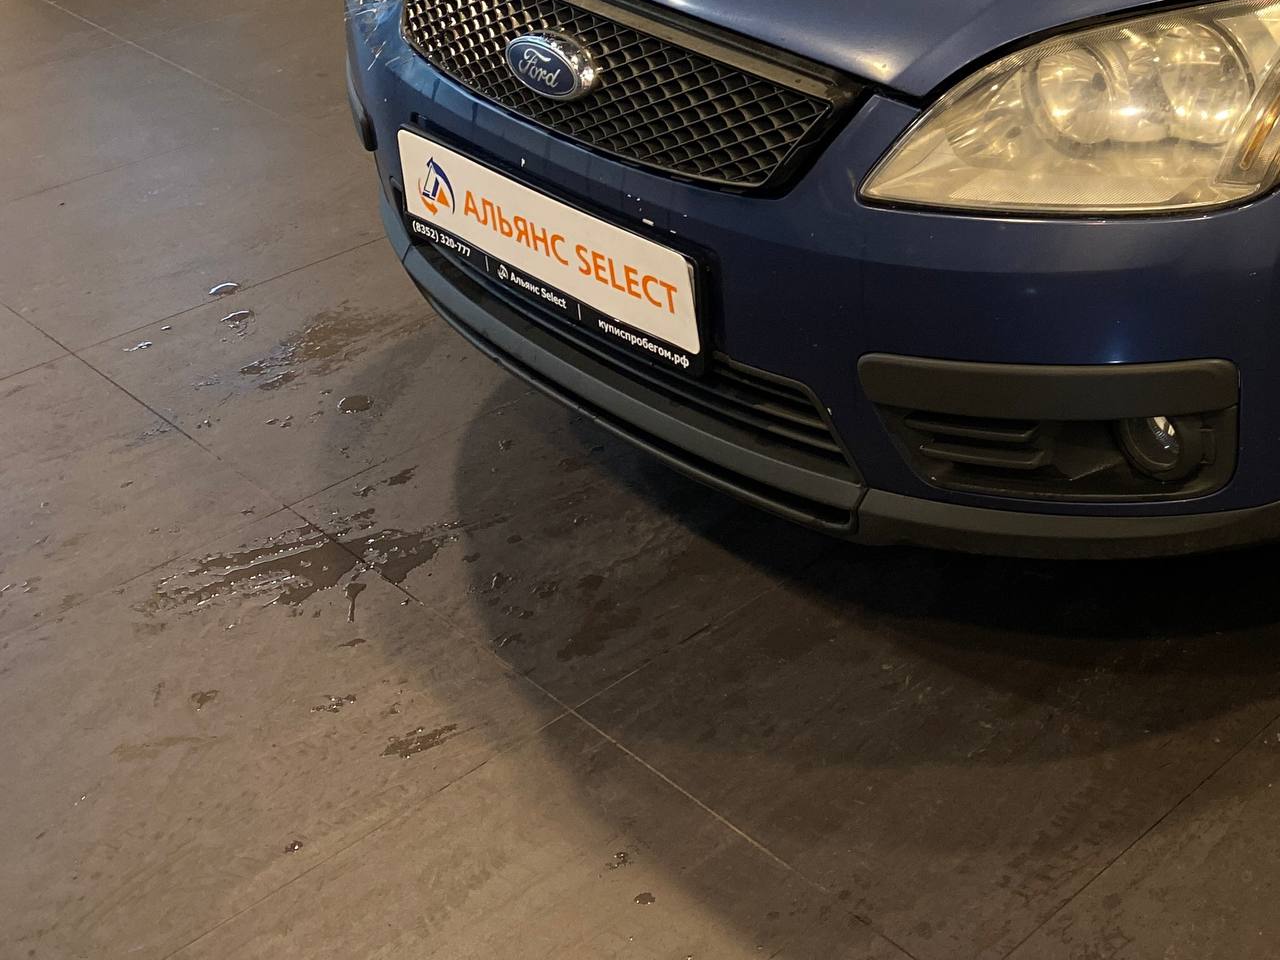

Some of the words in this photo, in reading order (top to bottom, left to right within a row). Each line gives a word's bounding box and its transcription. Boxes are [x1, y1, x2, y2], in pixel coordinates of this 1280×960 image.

[518, 48, 561, 88] Ford
[412, 220, 439, 243] (8352)
[440, 235, 471, 256] 320-777
[510, 272, 540, 295] Альянс
[541, 288, 567, 309] Select
[598, 319, 690, 368] куписпробегом.рф
[464, 190, 569, 266] АЛЬЯНС
[575, 244, 678, 314] SELECT
